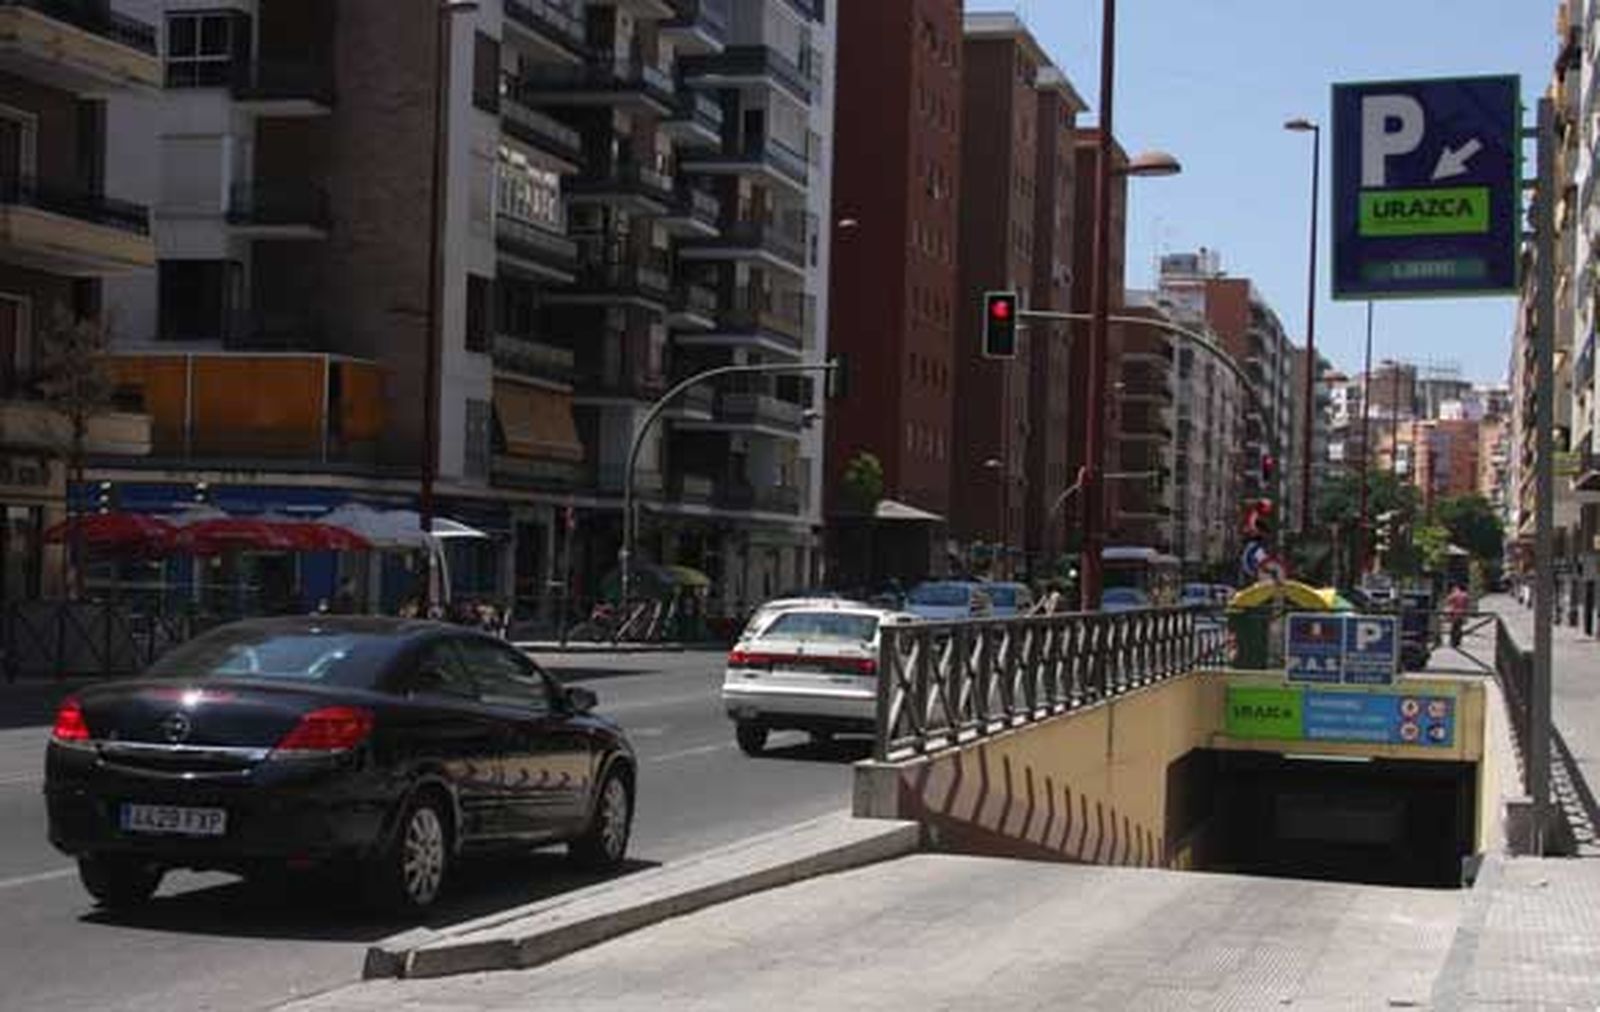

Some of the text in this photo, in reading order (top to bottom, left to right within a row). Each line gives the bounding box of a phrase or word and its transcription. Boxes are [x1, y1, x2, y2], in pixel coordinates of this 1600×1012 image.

[1361, 94, 1425, 187] P
[1371, 197, 1474, 219] URAZCA
[1356, 621, 1382, 650] P
